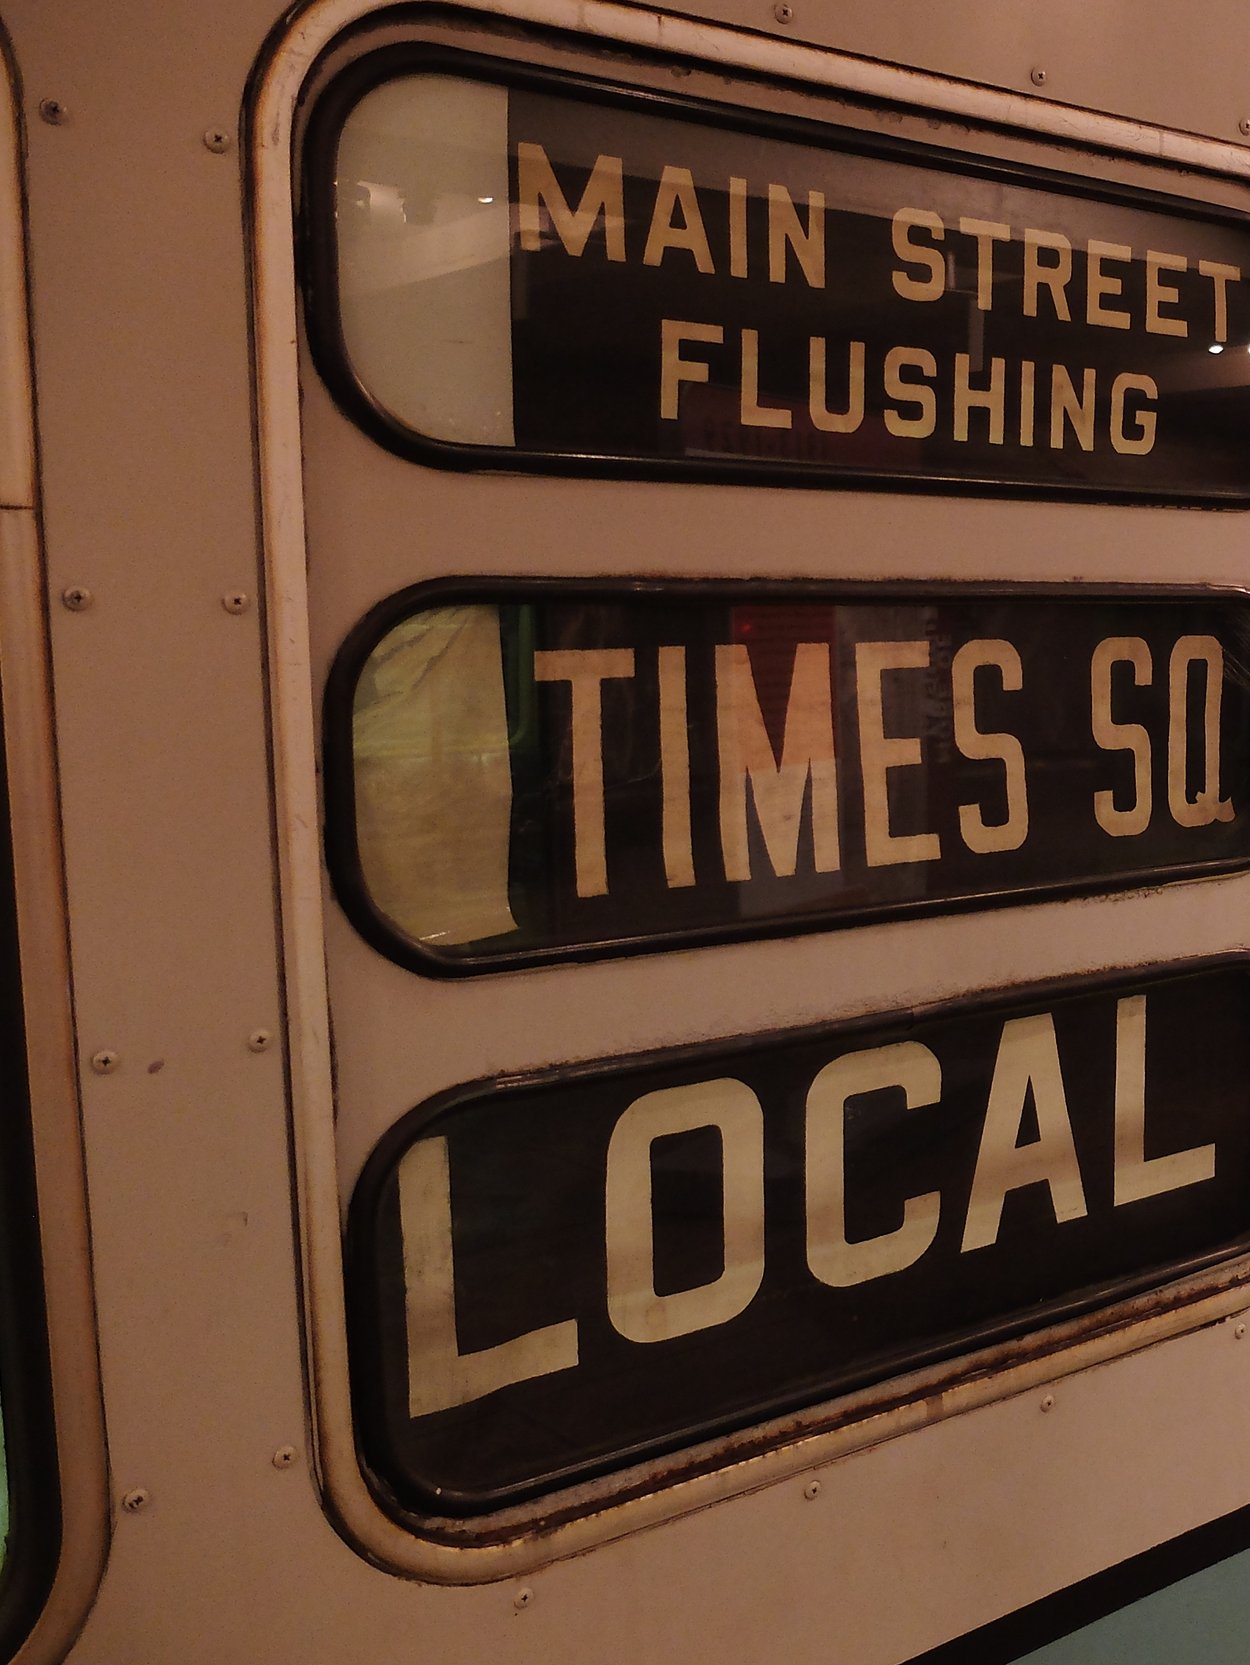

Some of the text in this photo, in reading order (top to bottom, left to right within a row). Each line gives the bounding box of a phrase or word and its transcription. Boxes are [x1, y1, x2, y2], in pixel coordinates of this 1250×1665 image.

[517, 142, 1241, 343] MAIN STREET
[659, 319, 1158, 456] FLUSHING
[534, 637, 1030, 899] TIMES
[1091, 635, 1235, 838] SQ
[400, 994, 1216, 1420] LOCAL
